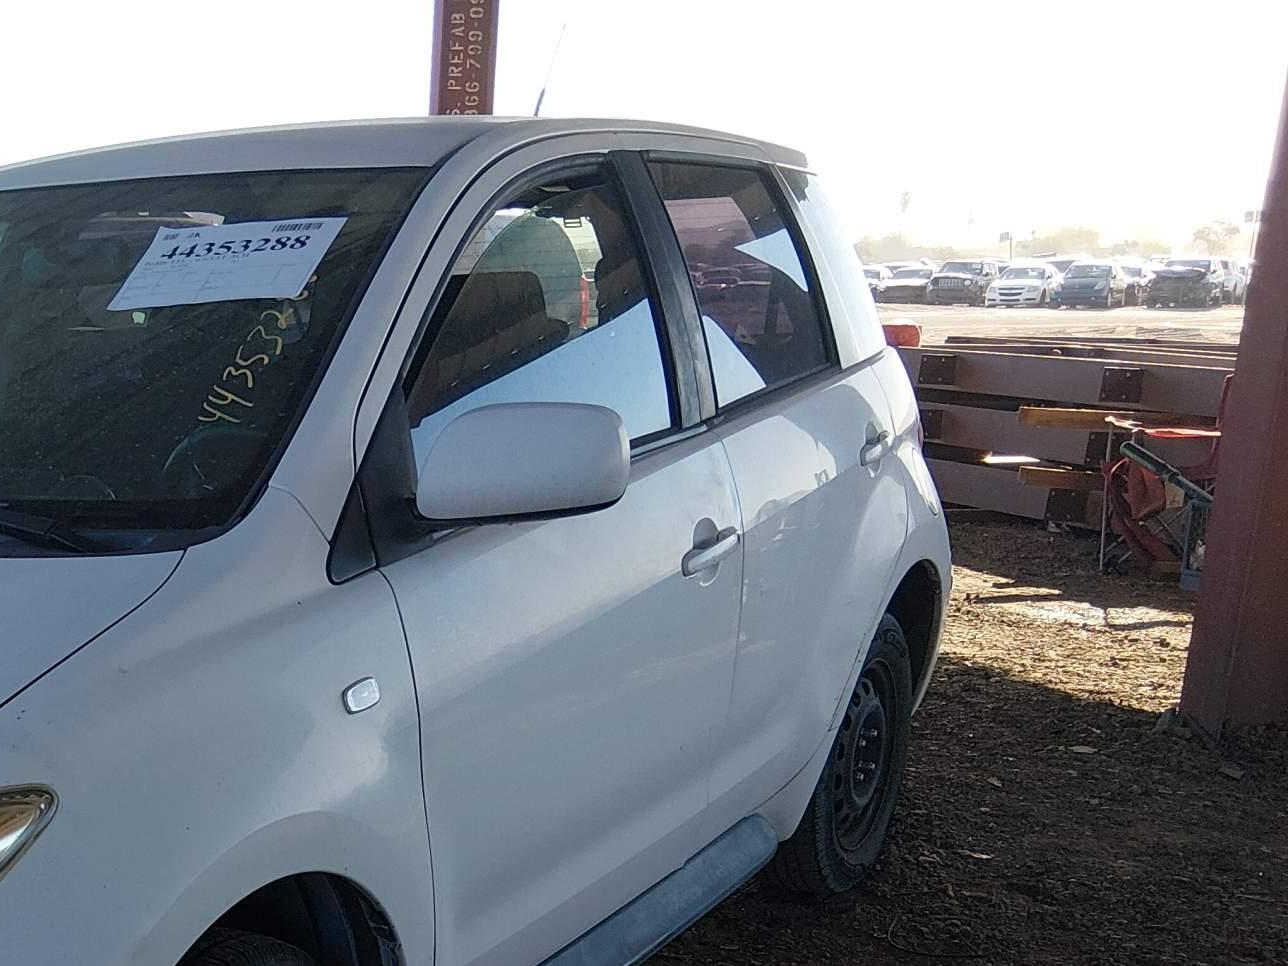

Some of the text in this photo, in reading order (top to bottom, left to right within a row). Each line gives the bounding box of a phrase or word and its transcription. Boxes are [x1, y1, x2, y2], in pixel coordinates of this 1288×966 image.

[447, 13, 465, 90] PREFAB
[161, 234, 311, 260] 44353288
[197, 275, 317, 423] 443532
